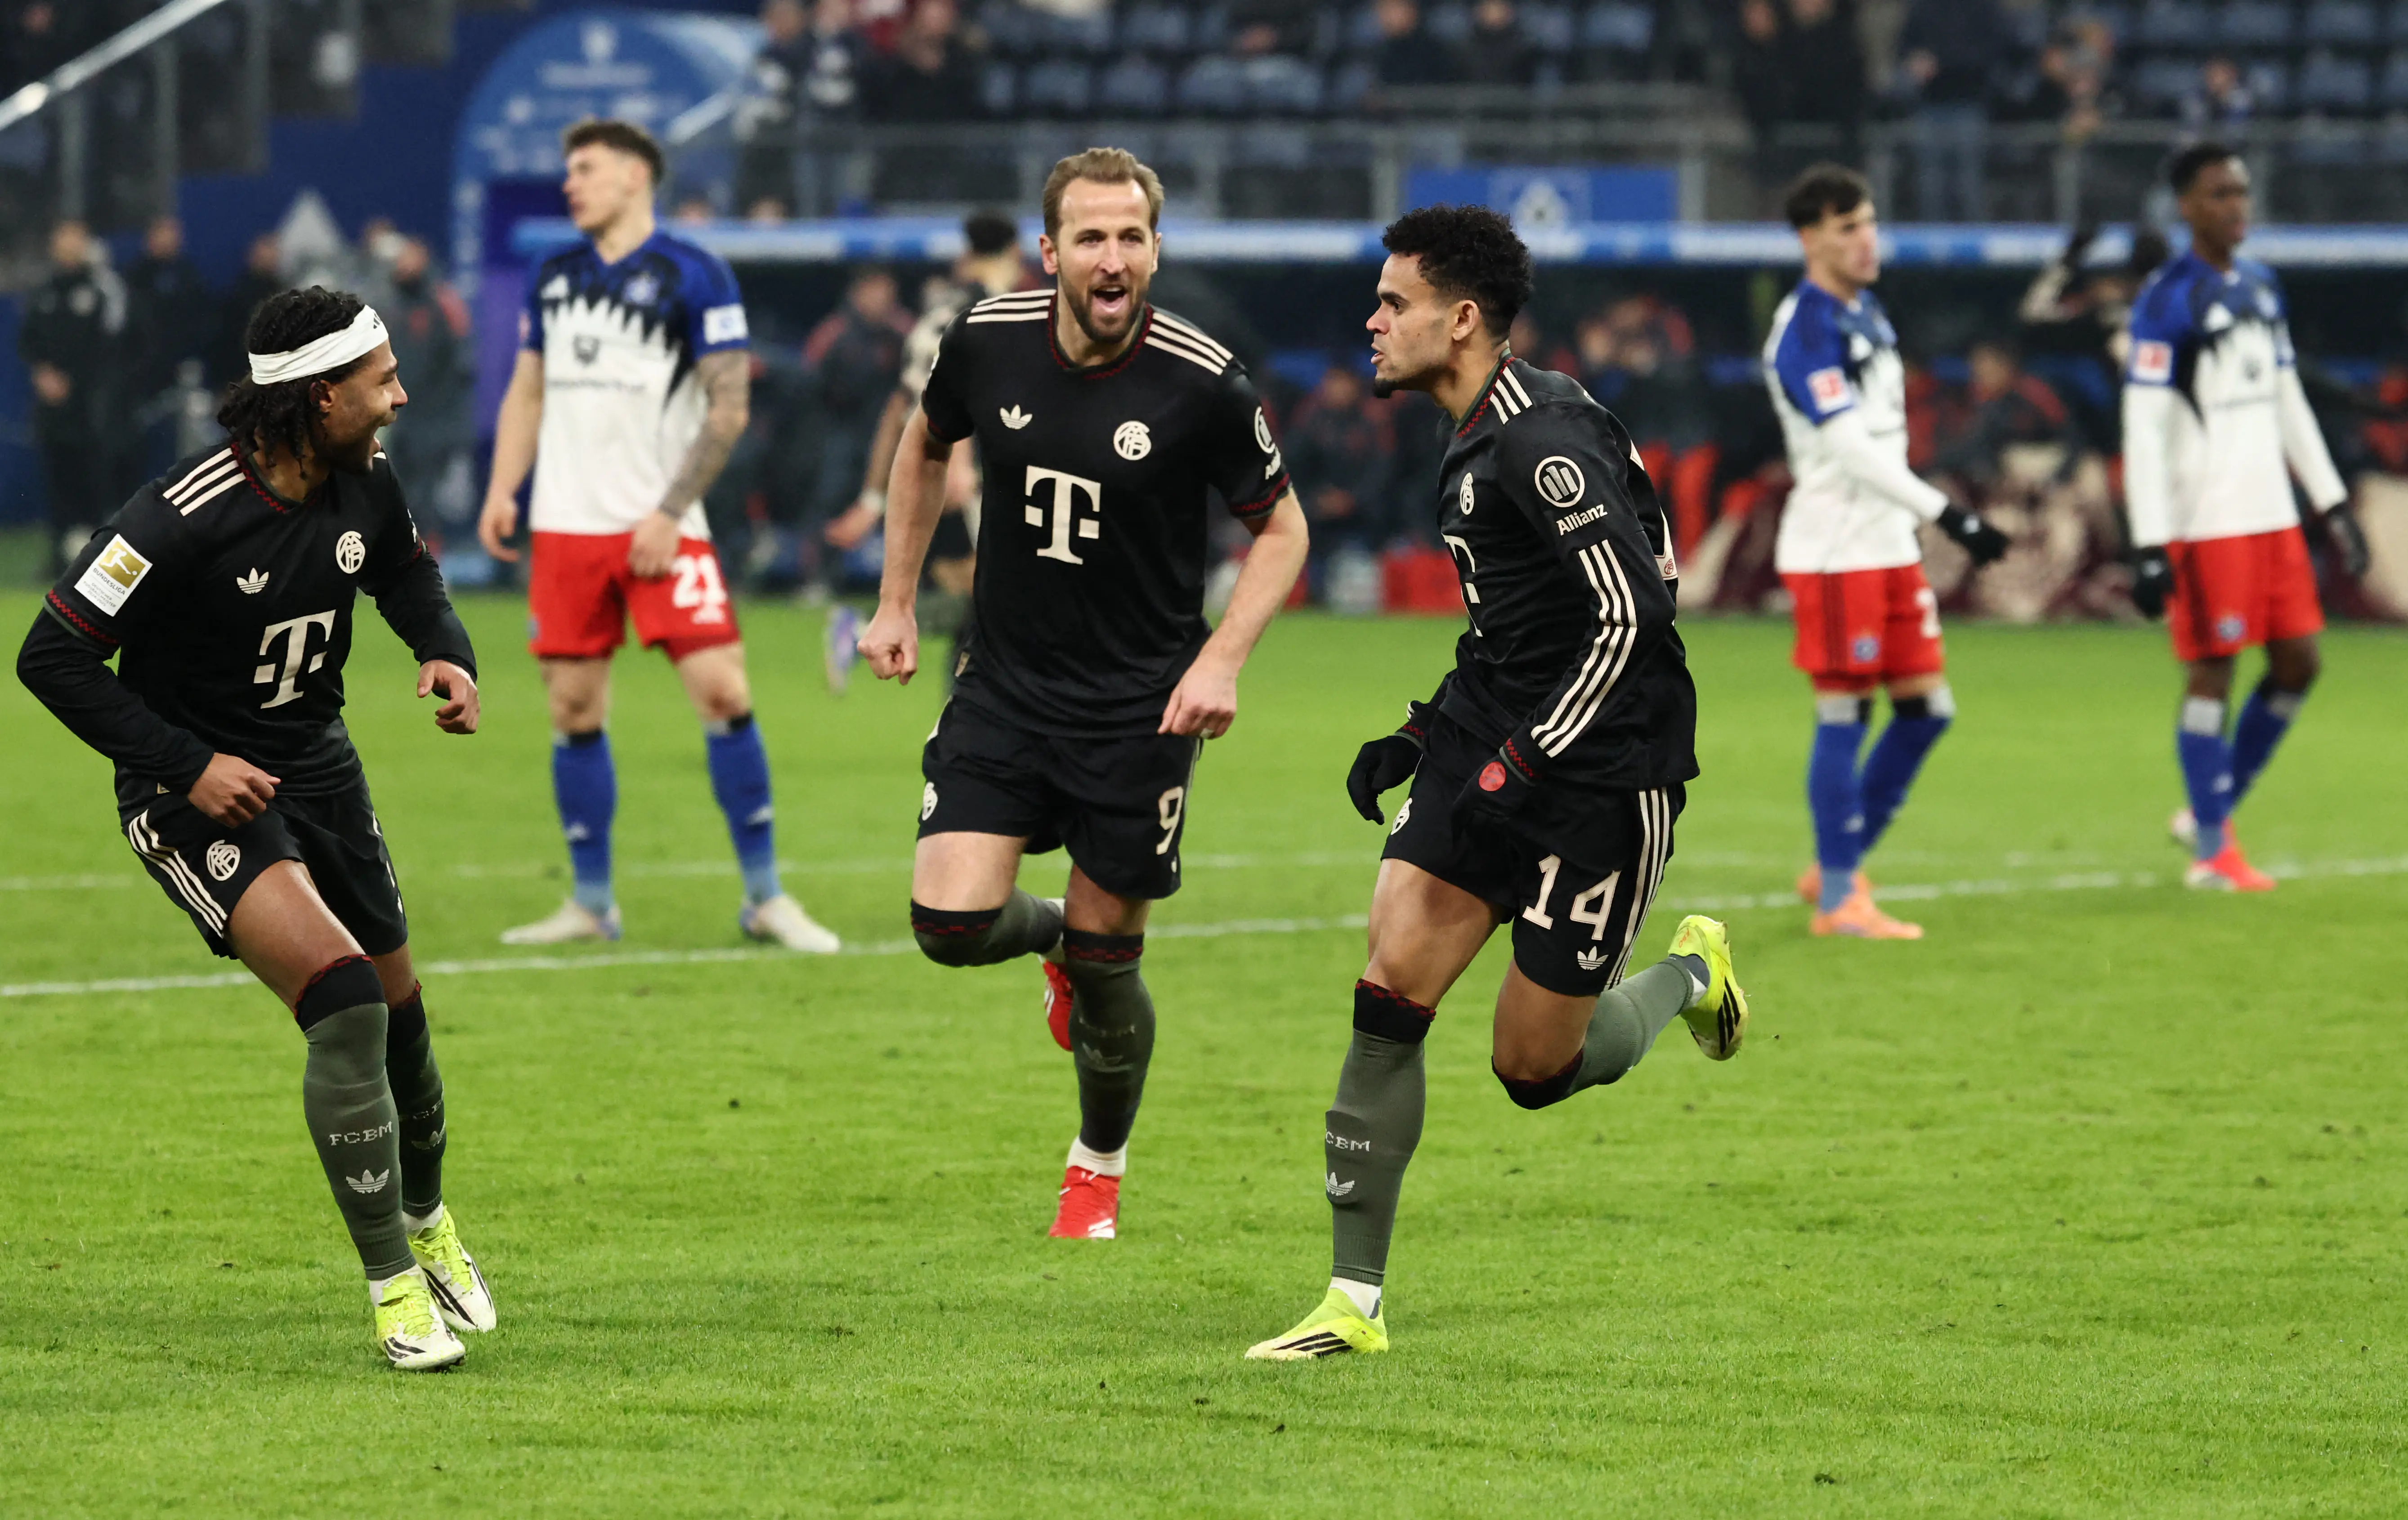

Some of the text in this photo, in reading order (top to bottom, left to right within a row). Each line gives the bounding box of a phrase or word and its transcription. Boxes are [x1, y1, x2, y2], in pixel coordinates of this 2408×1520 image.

[1025, 465, 1101, 565] T
[1556, 504, 1608, 536] Allianz
[93, 568, 126, 595] BUNDESLIGA
[672, 554, 728, 623] 21
[253, 609, 336, 709] T
[1156, 786, 1183, 855] 9
[1522, 854, 1621, 941] 14
[328, 1121, 392, 1146] FCBM
[1325, 1128, 1370, 1152] CBM
